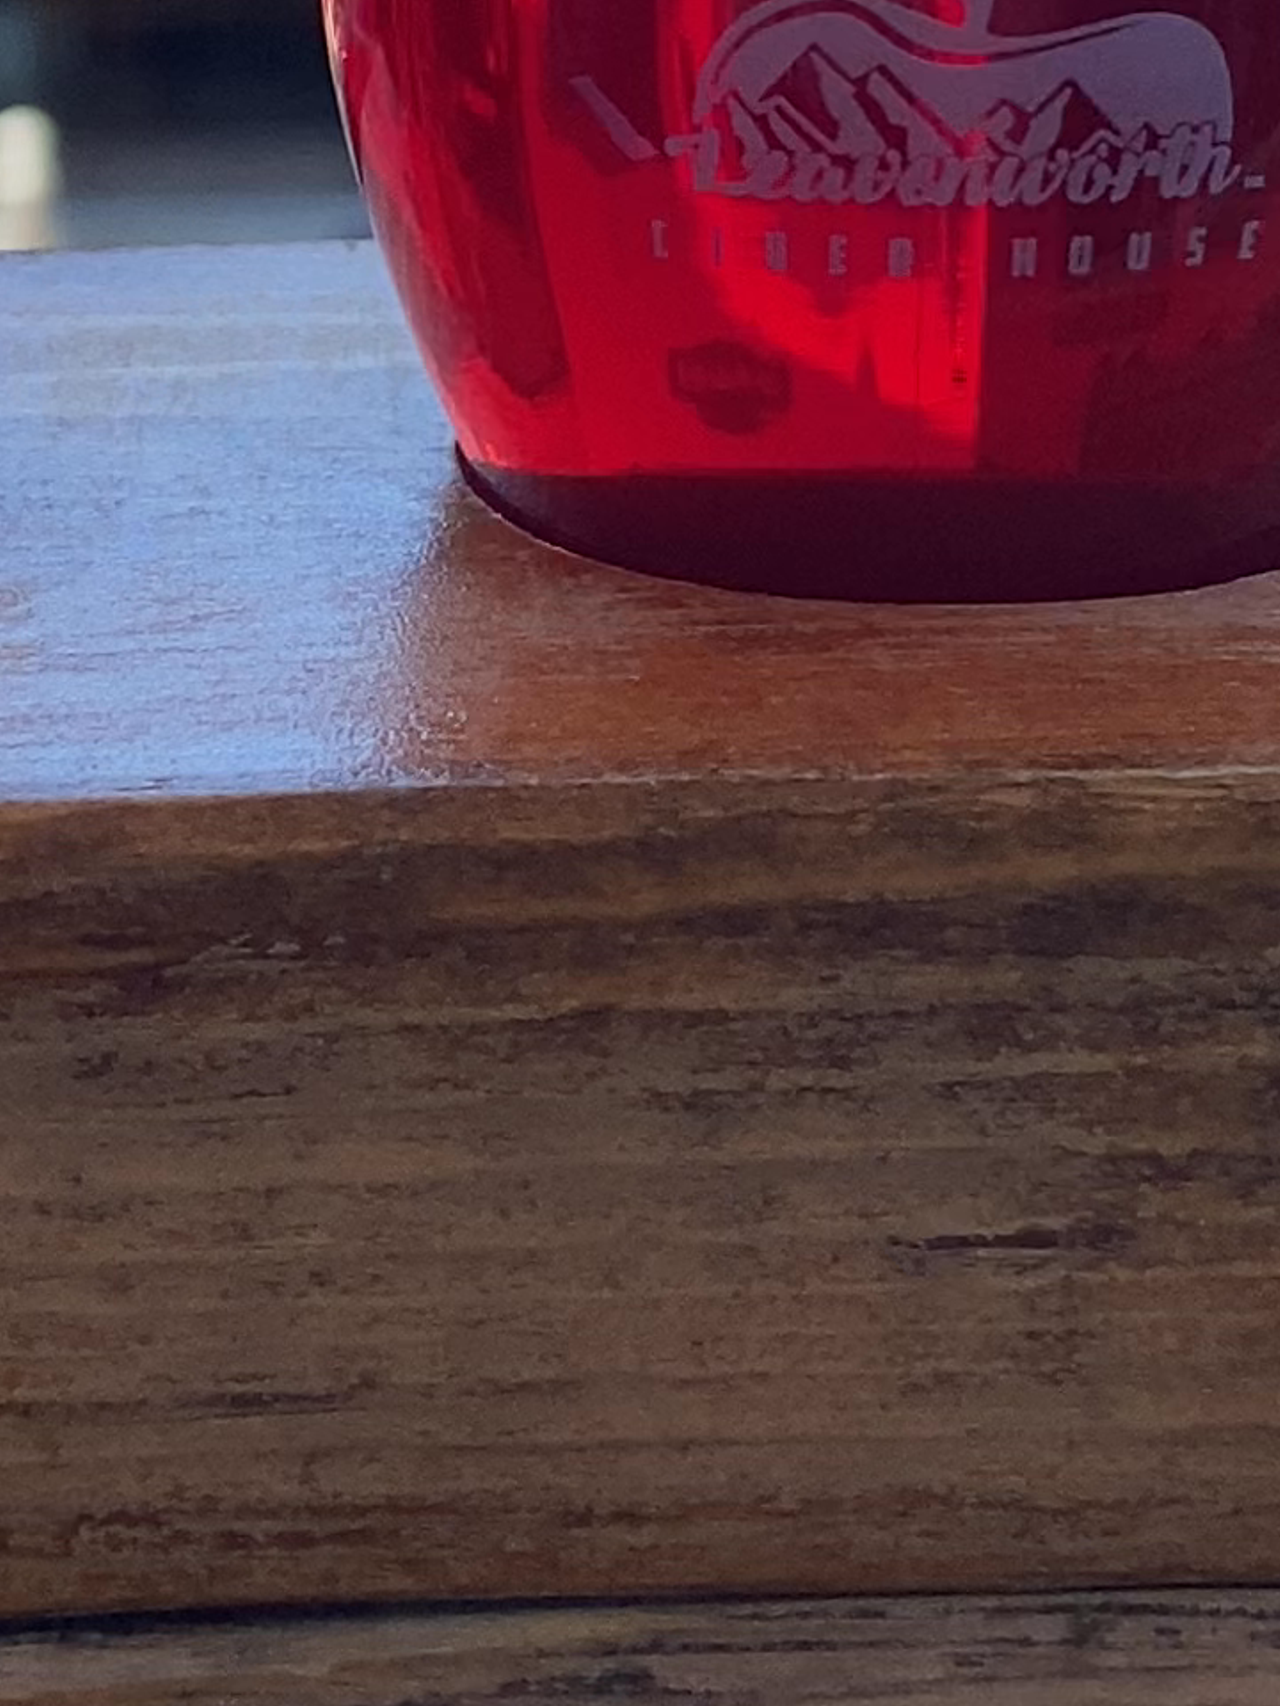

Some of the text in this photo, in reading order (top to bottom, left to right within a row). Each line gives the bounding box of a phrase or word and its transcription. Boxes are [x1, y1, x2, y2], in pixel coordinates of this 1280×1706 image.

[663, 123, 1242, 206] Leavenworth
[651, 219, 1264, 278] CIDER HOUSE
